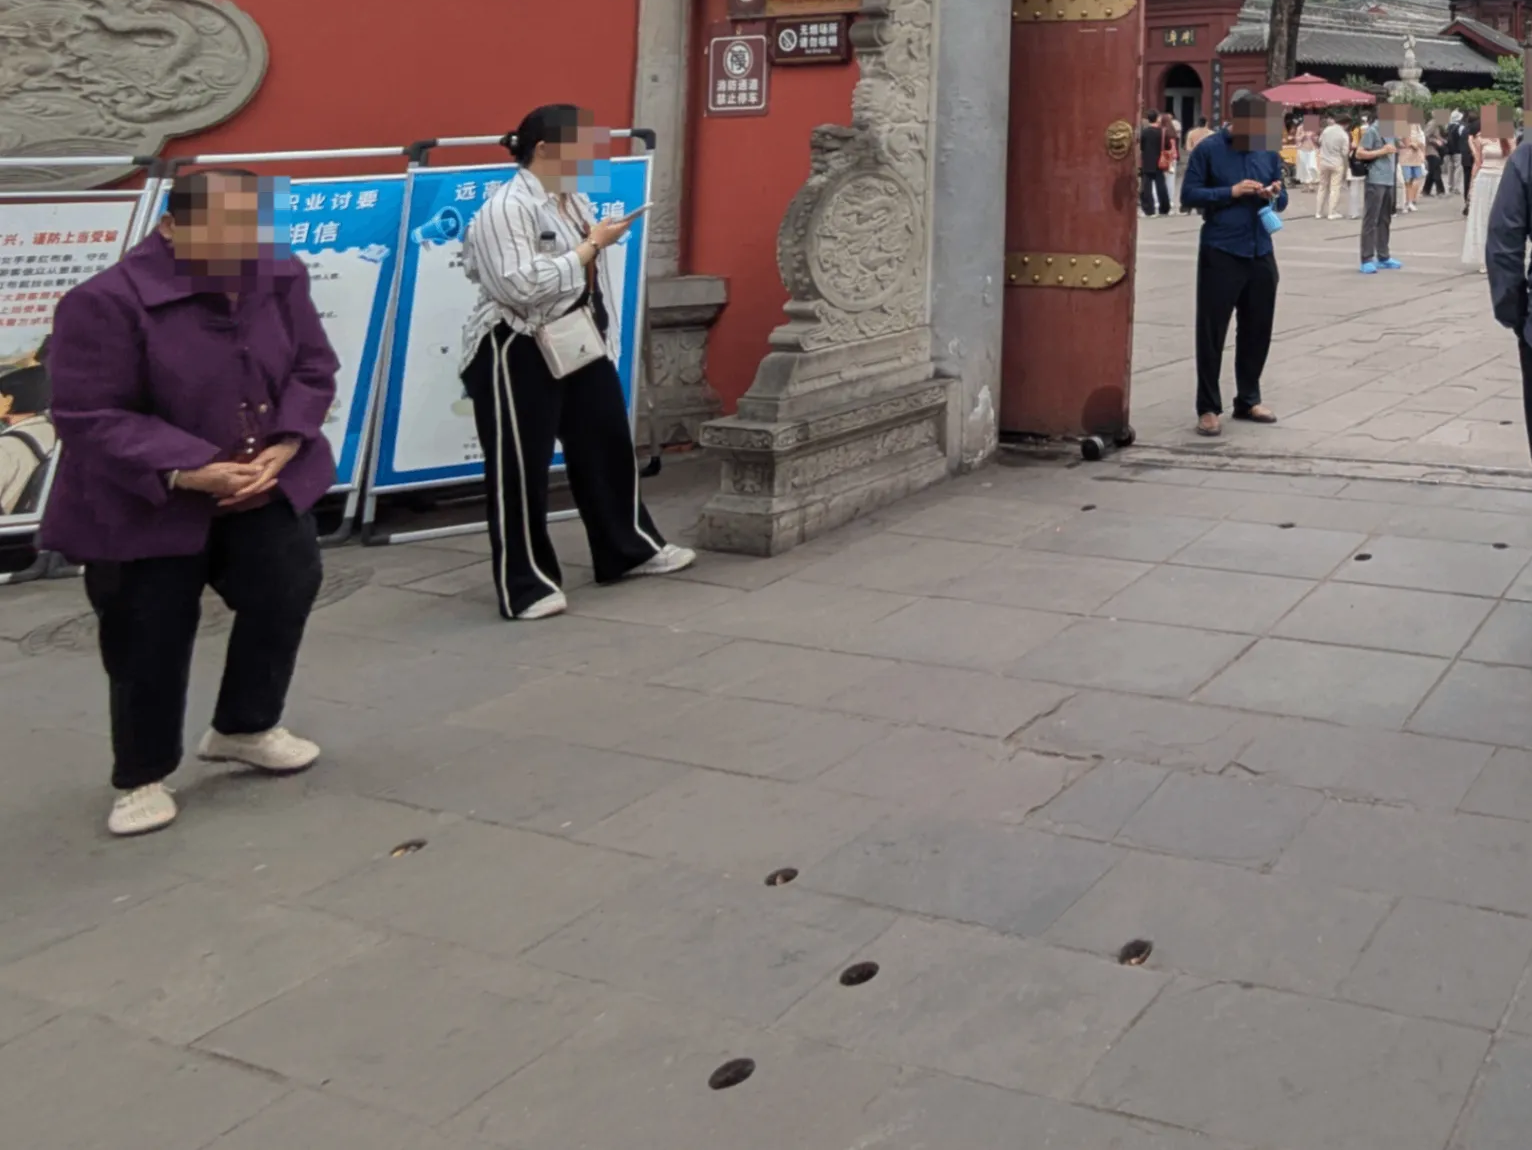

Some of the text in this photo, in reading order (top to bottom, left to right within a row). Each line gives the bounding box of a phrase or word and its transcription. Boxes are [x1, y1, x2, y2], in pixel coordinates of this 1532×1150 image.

[717, 79, 758, 91] 消防通道
[716, 92, 758, 105] 禁止停车
[0, 231, 118, 246] 兴，谨防上当受骗
